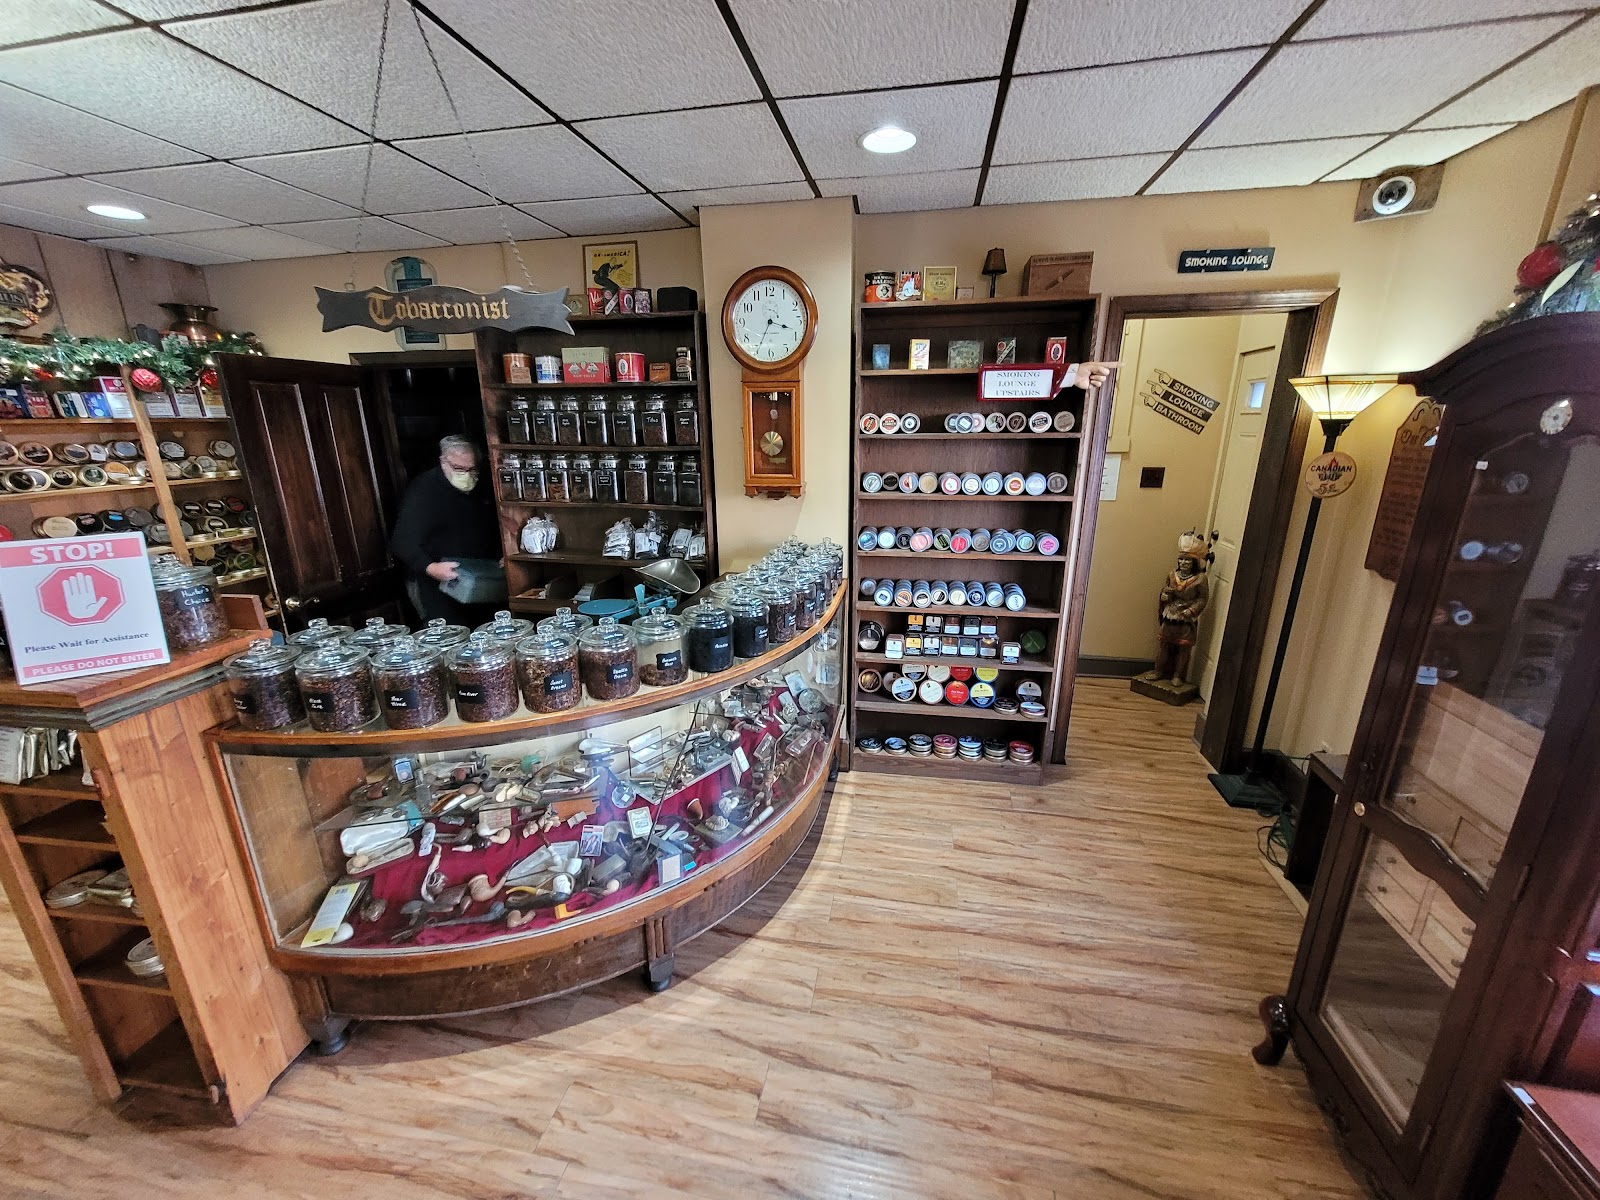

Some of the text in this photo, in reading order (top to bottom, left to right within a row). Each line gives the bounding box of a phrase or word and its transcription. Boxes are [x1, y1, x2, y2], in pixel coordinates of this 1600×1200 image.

[1185, 255, 1268, 267] SMOKING LOUNGE
[753, 290, 760, 301] 11
[766, 286, 775, 296] 12
[367, 293, 510, 326] Tobacconist
[744, 302, 752, 313] 10
[792, 301, 798, 312] 2
[739, 318, 746, 328] 9
[744, 333, 750, 343] 8
[768, 349, 774, 358] 6
[1173, 382, 1214, 408] SMOKING
[1169, 395, 1204, 417] LOUNGE
[1156, 404, 1202, 433] BATHROOM
[30, 542, 114, 564] STOP!
[25, 632, 149, 654] Please Wait for Assistance
[32, 652, 156, 676] PLEASE DO NOT ENTER
